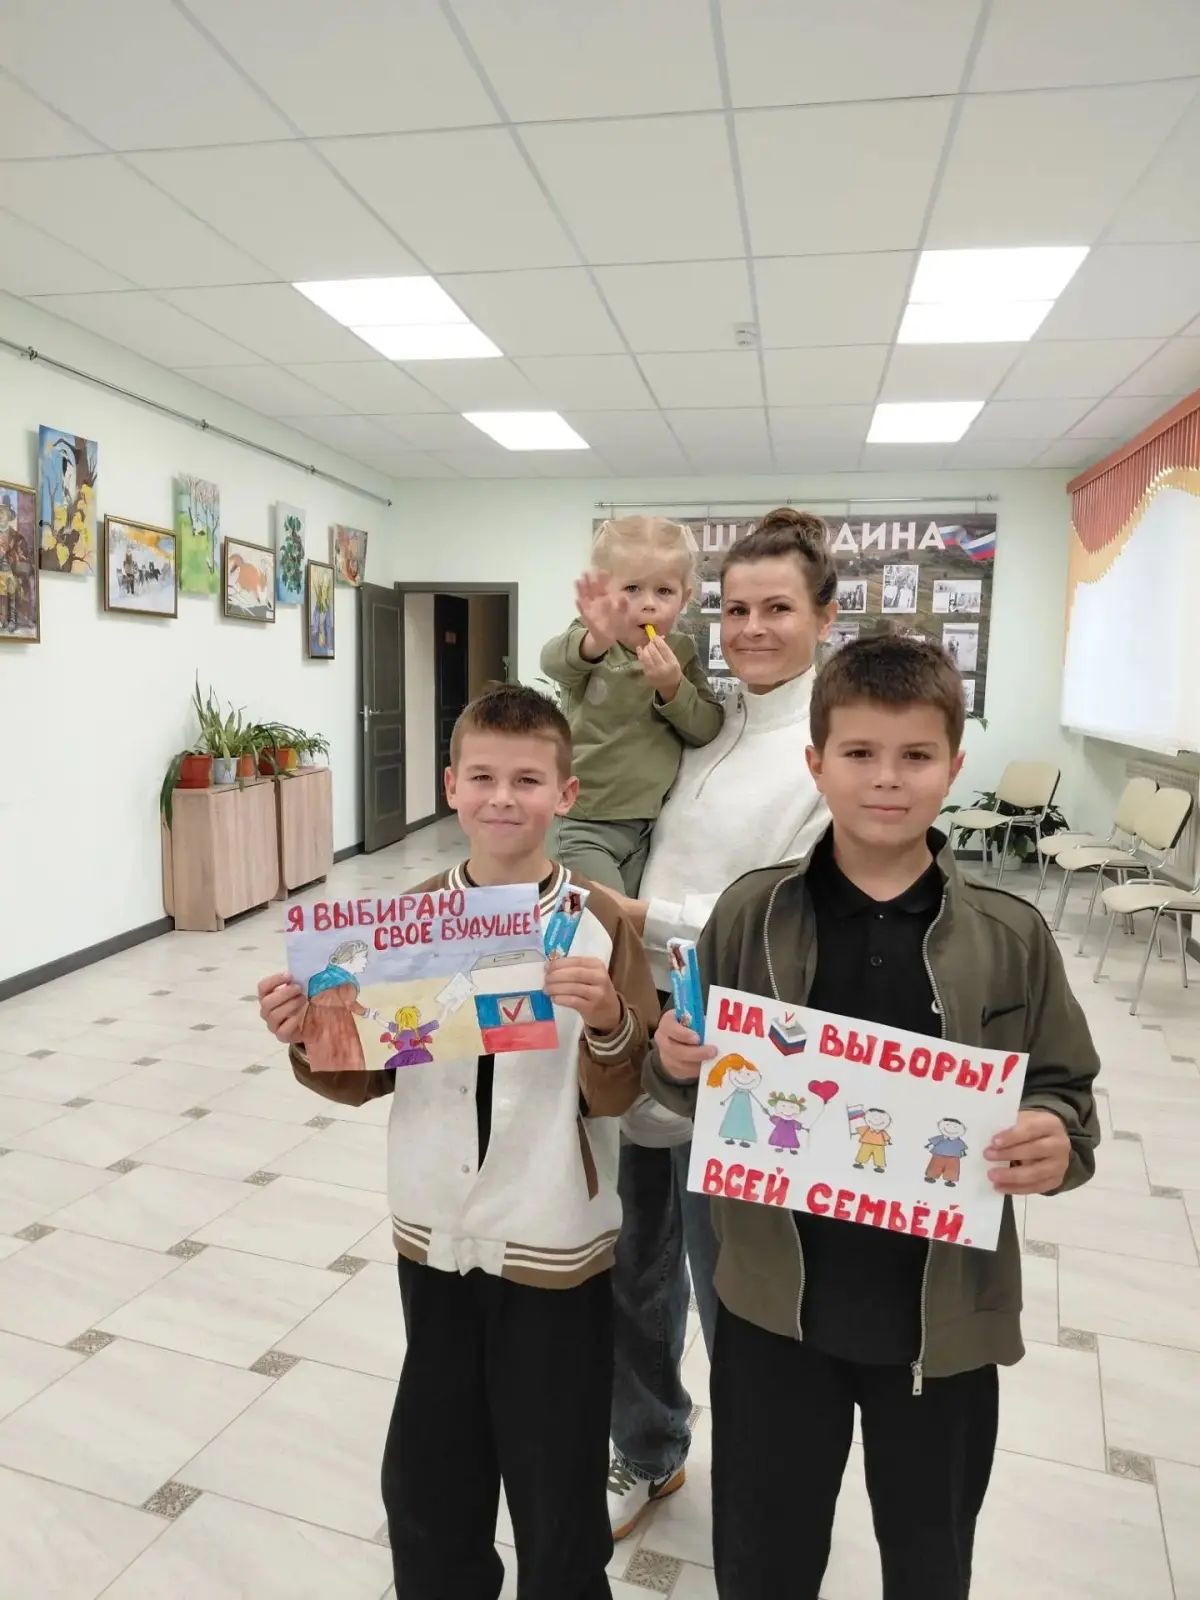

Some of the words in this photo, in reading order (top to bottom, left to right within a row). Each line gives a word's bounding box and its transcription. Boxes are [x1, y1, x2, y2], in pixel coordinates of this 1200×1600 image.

[286, 905, 304, 932] Я
[314, 889, 465, 931] ВЫБИРАЮ
[717, 998, 765, 1038] НА
[819, 1024, 1020, 1094] ВЫБОРЫ!
[702, 1158, 790, 1206] ВСЕЙ
[806, 1182, 973, 1246] СЕМЬЁЙ.
